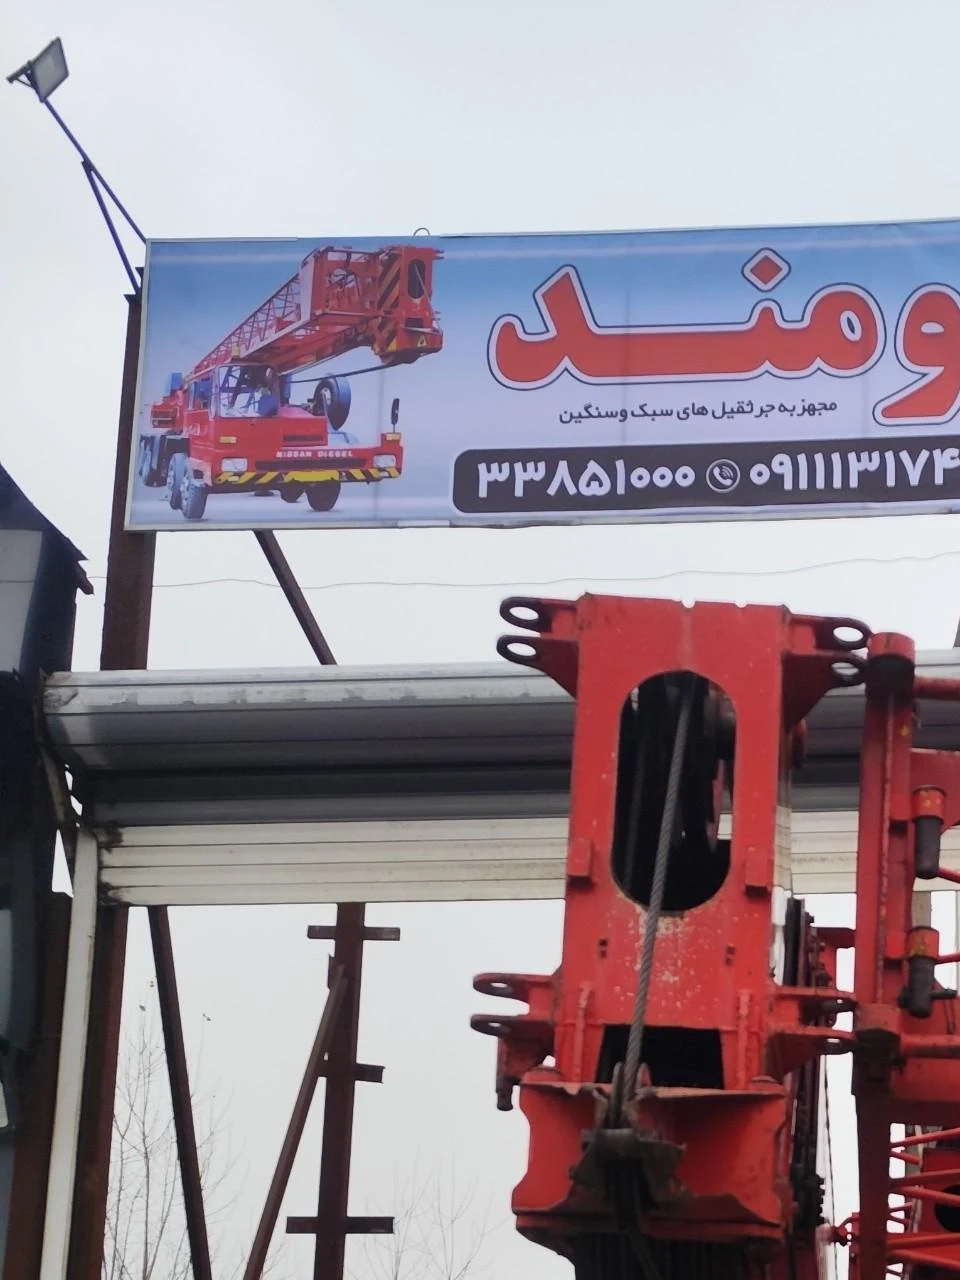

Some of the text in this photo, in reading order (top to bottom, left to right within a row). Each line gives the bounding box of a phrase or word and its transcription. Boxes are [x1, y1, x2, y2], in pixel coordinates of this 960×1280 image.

[630, 403, 674, 421] سبک
[676, 401, 709, 421] های
[477, 459, 696, 498] ۳۳۸۵۱۰۰۰
